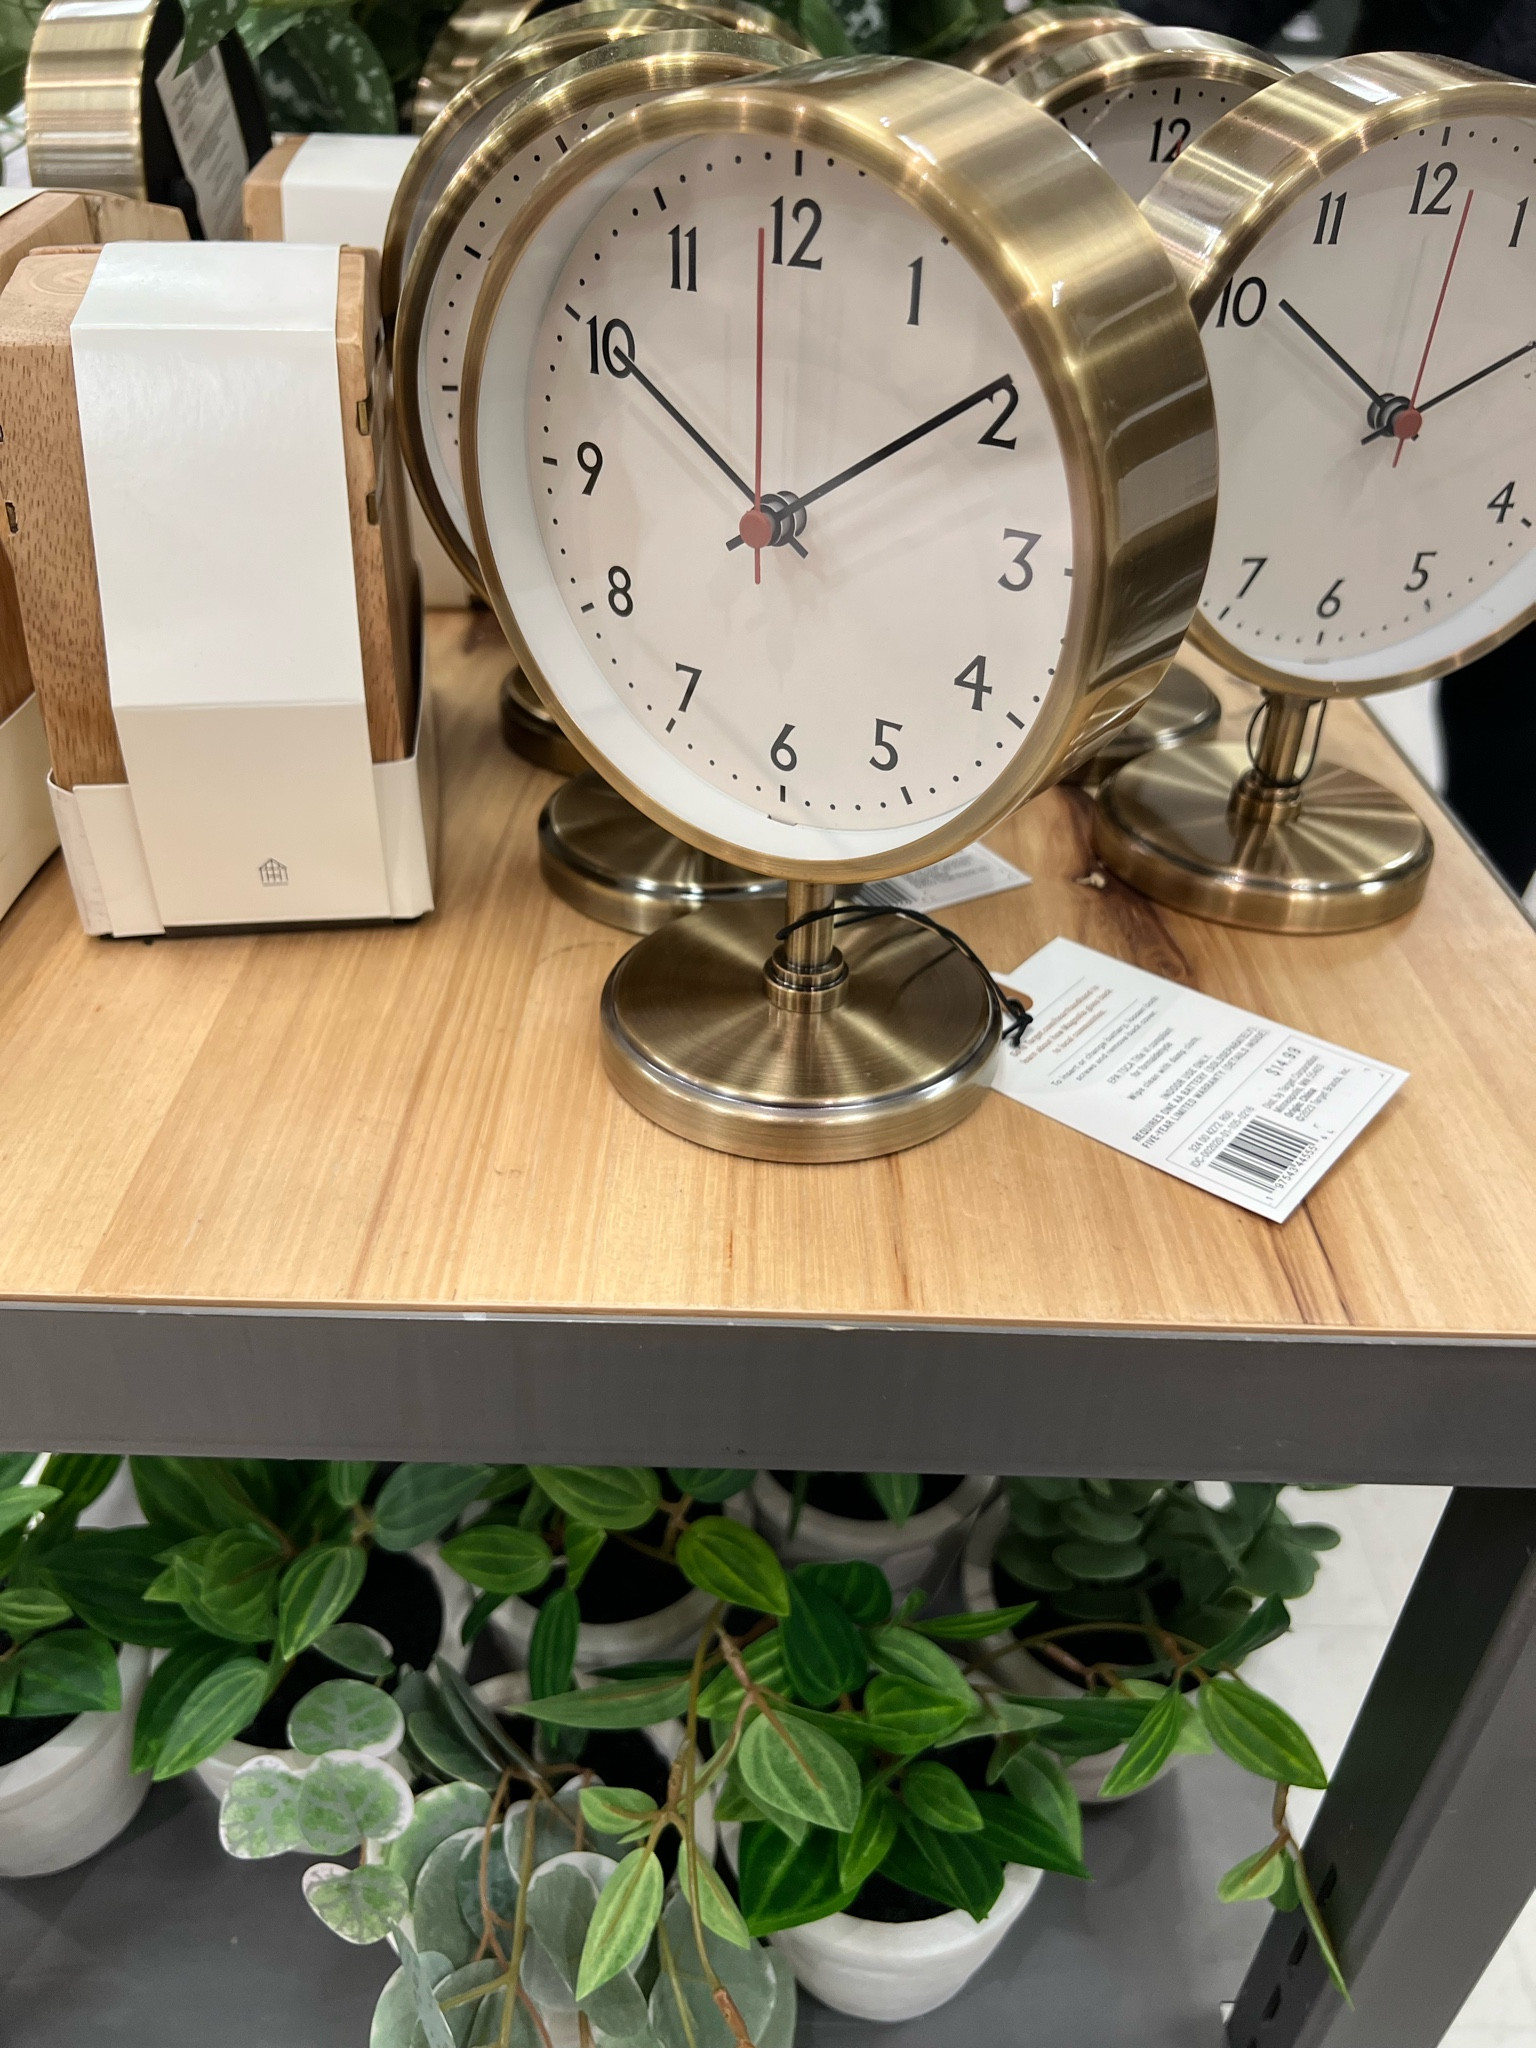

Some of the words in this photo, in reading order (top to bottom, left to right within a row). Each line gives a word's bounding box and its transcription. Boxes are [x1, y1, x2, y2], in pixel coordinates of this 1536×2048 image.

[1409, 161, 1453, 215] 12
[770, 196, 823, 270] 12
[1314, 192, 1347, 245] 11
[1508, 197, 1529, 248] 1
[668, 224, 698, 292] 11
[906, 256, 924, 326] 1
[1215, 276, 1267, 328] 10
[586, 315, 636, 379] 10
[977, 378, 1018, 450] 2
[577, 441, 604, 495] 9
[1487, 480, 1516, 524] 4
[997, 527, 1042, 592] 3
[1237, 556, 1268, 599] 7
[1404, 550, 1437, 593] 5
[608, 565, 634, 618] 8
[1317, 578, 1345, 620] 6
[676, 662, 703, 713] 7
[954, 655, 993, 712] 4
[771, 723, 798, 772] 6
[869, 717, 904, 772] 5
[1058, 1063, 1080, 1079] insert
[1081, 1040, 1109, 1060] change
[1073, 1062, 1098, 1081] screws
[1092, 1053, 1108, 1064] and
[1104, 1035, 1130, 1054] remove
[1124, 1024, 1142, 1036] back
[1126, 1086, 1146, 1101] Wipe
[1140, 1072, 1161, 1088] clean
[1155, 1062, 1172, 1073] with
[1167, 1048, 1188, 1063] damp
[1130, 1113, 1165, 1142] REQUIRES
[1158, 1102, 1177, 1115] ONE
[1178, 1071, 1209, 1096] BATTERY
[1140, 1119, 1176, 1149] FIVE-YEAR
[1169, 1097, 1198, 1121] LIMITED
[1191, 1069, 1227, 1099] WARRANTY
[1159, 1078, 1186, 1100] INDOOR
[1180, 1067, 1197, 1079] USE
